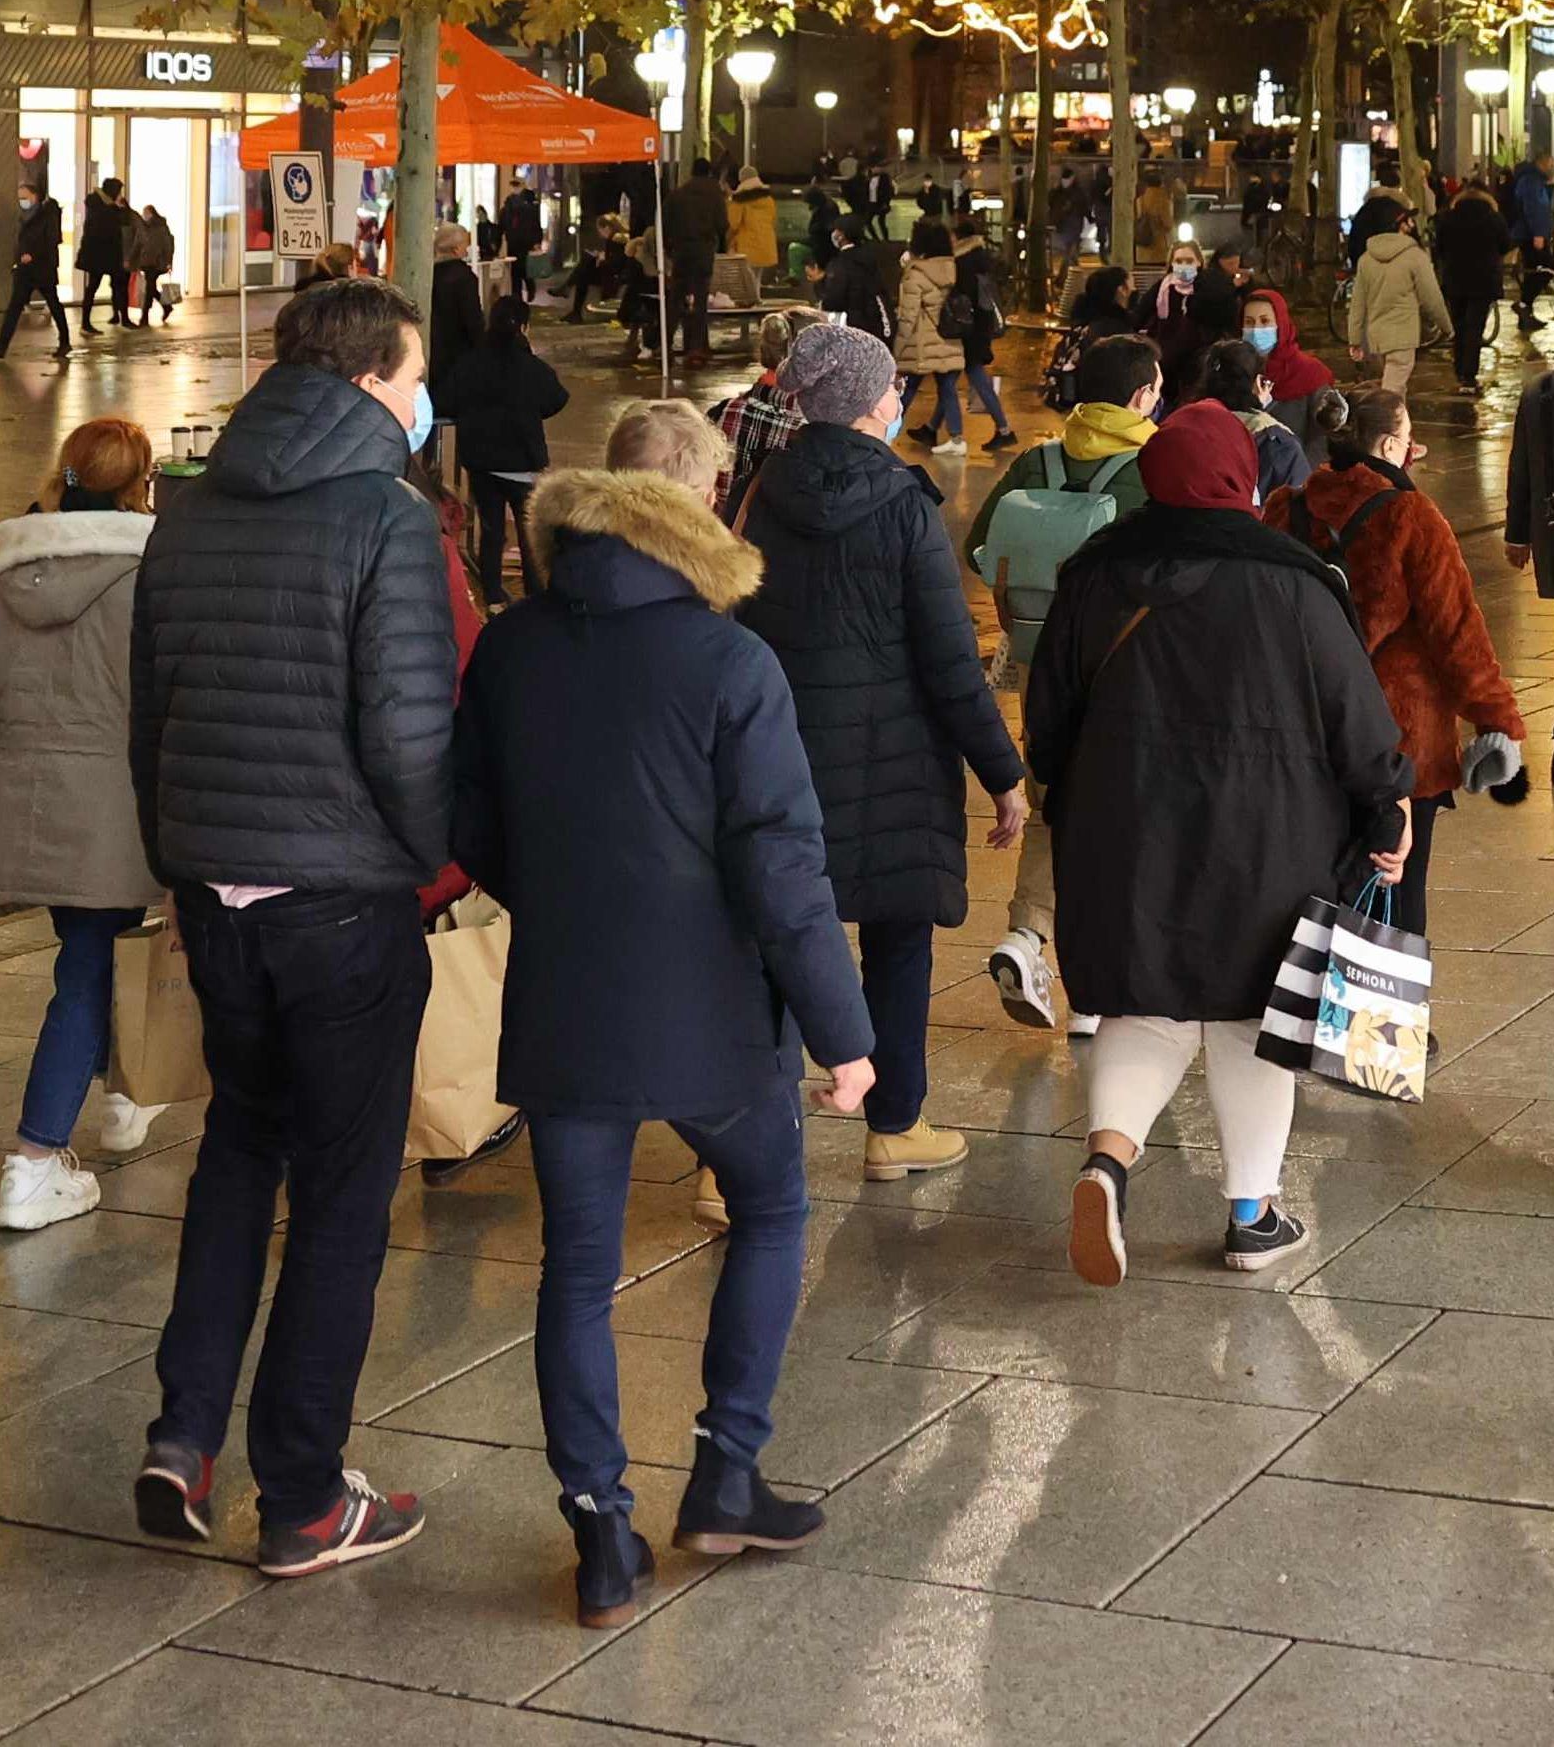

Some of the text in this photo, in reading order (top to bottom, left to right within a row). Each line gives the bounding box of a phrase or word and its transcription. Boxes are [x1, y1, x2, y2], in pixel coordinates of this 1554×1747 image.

[146, 51, 212, 84] IQOS
[283, 230, 289, 248] 8
[300, 231, 312, 248] 22
[315, 232, 322, 249] h
[1346, 964, 1396, 994] SEPHORA
